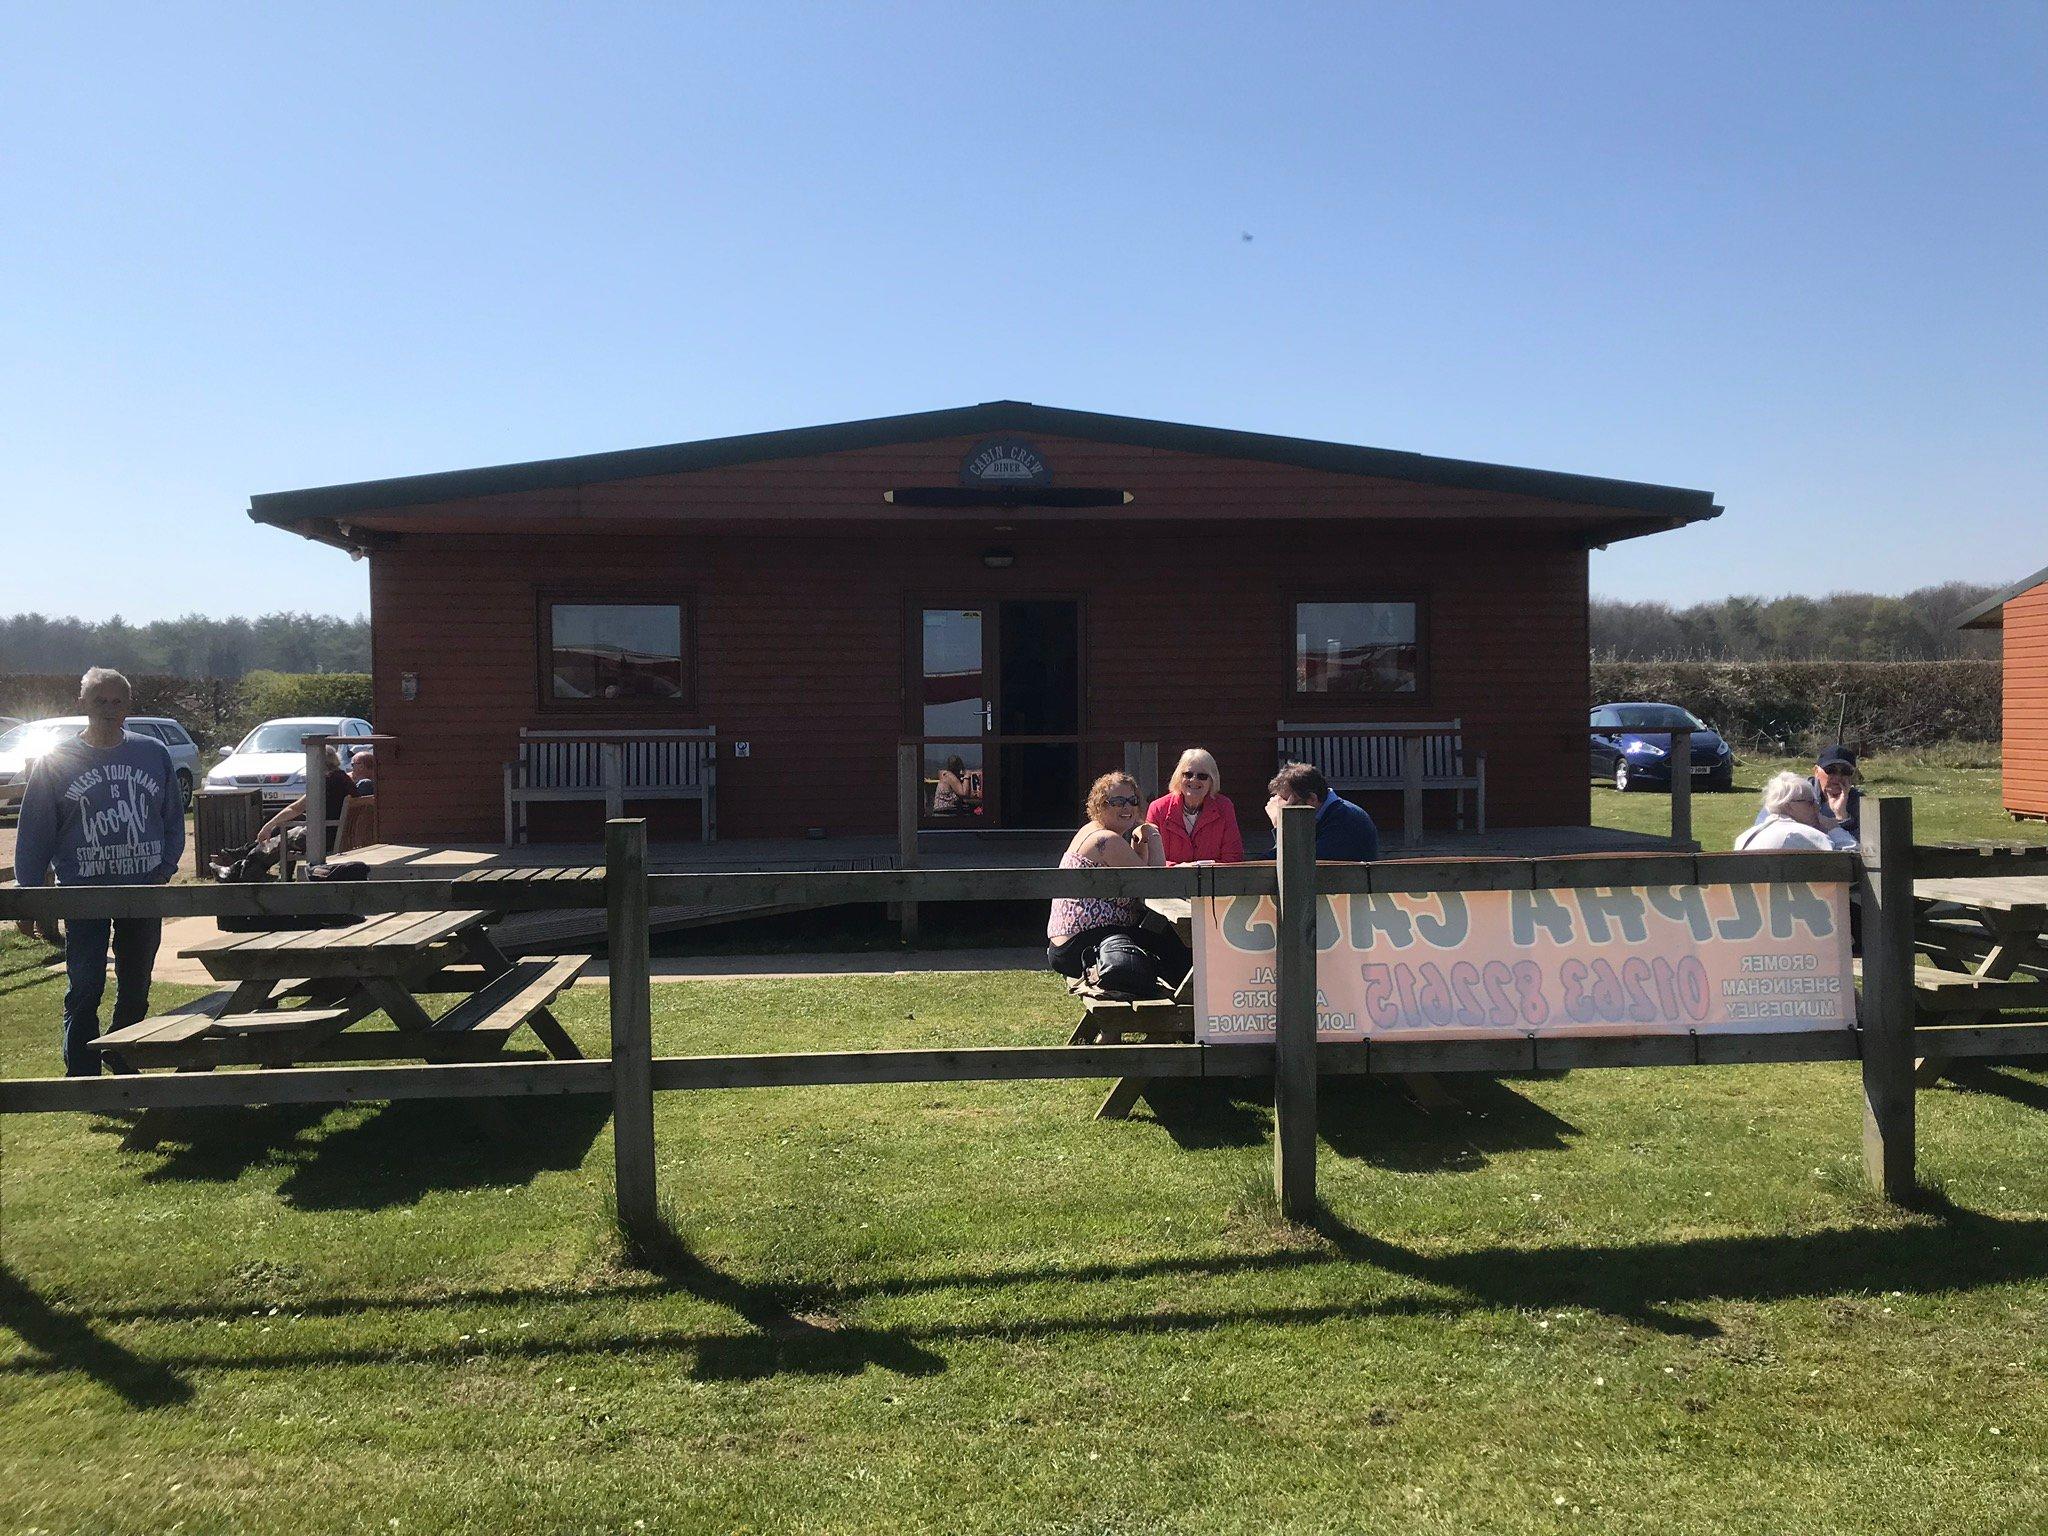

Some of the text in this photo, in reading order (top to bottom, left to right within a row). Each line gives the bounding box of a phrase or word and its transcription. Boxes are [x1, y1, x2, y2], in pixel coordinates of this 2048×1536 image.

[970, 446, 1043, 475] CABIN CREW
[994, 462, 1021, 473] DINER
[64, 764, 160, 802] UNLESS YOUR NAME
[110, 784, 121, 799] IS
[80, 778, 149, 851] Google
[77, 846, 98, 861] STOP
[99, 843, 132, 861] ACTING
[133, 841, 150, 857] LIKE
